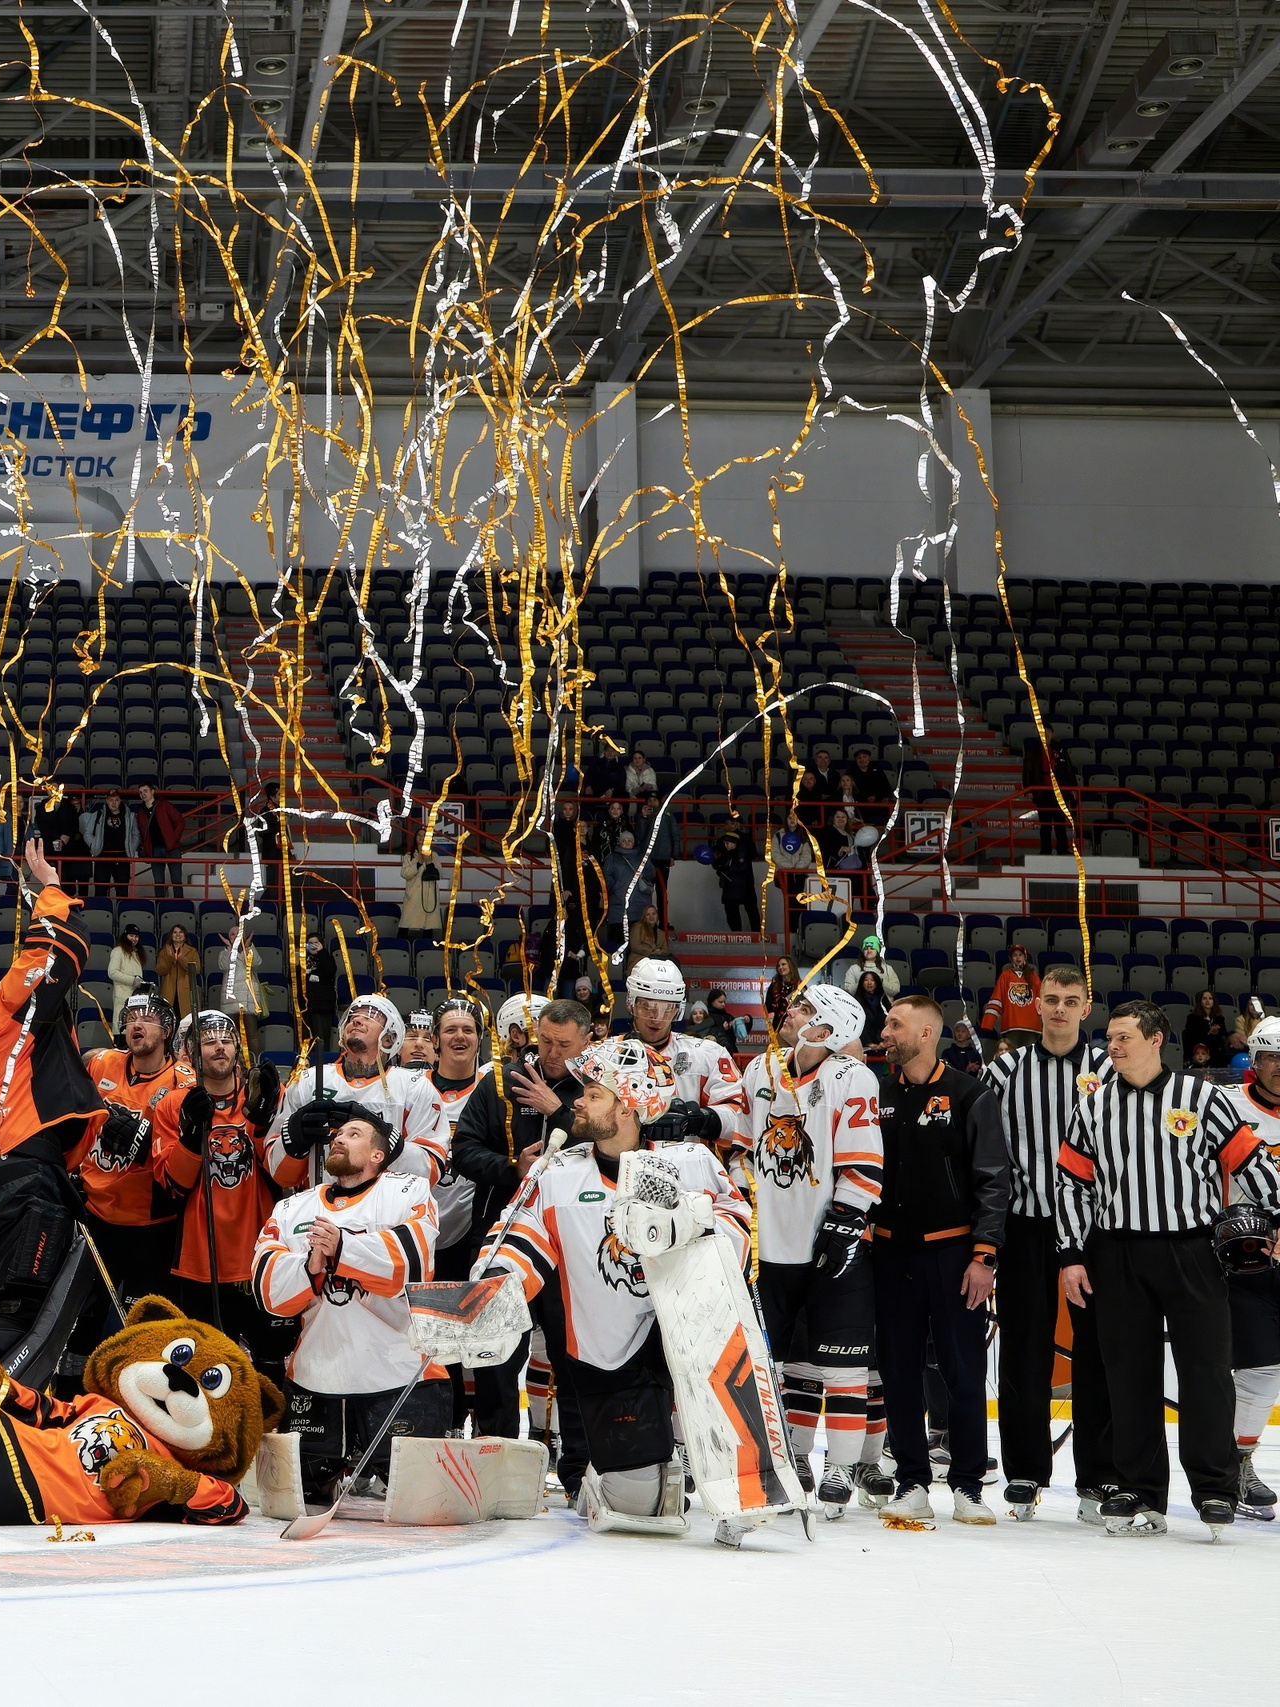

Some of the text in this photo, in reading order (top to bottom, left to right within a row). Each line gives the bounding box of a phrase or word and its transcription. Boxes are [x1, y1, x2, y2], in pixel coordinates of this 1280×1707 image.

[686, 933, 751, 943] ТЕРРИТОРИЯ ТИГРОВ
[709, 981, 750, 991] ТЕРРИТОРИЯ
[822, 1221, 865, 1237] CCM
[817, 1344, 870, 1355] BAUER
